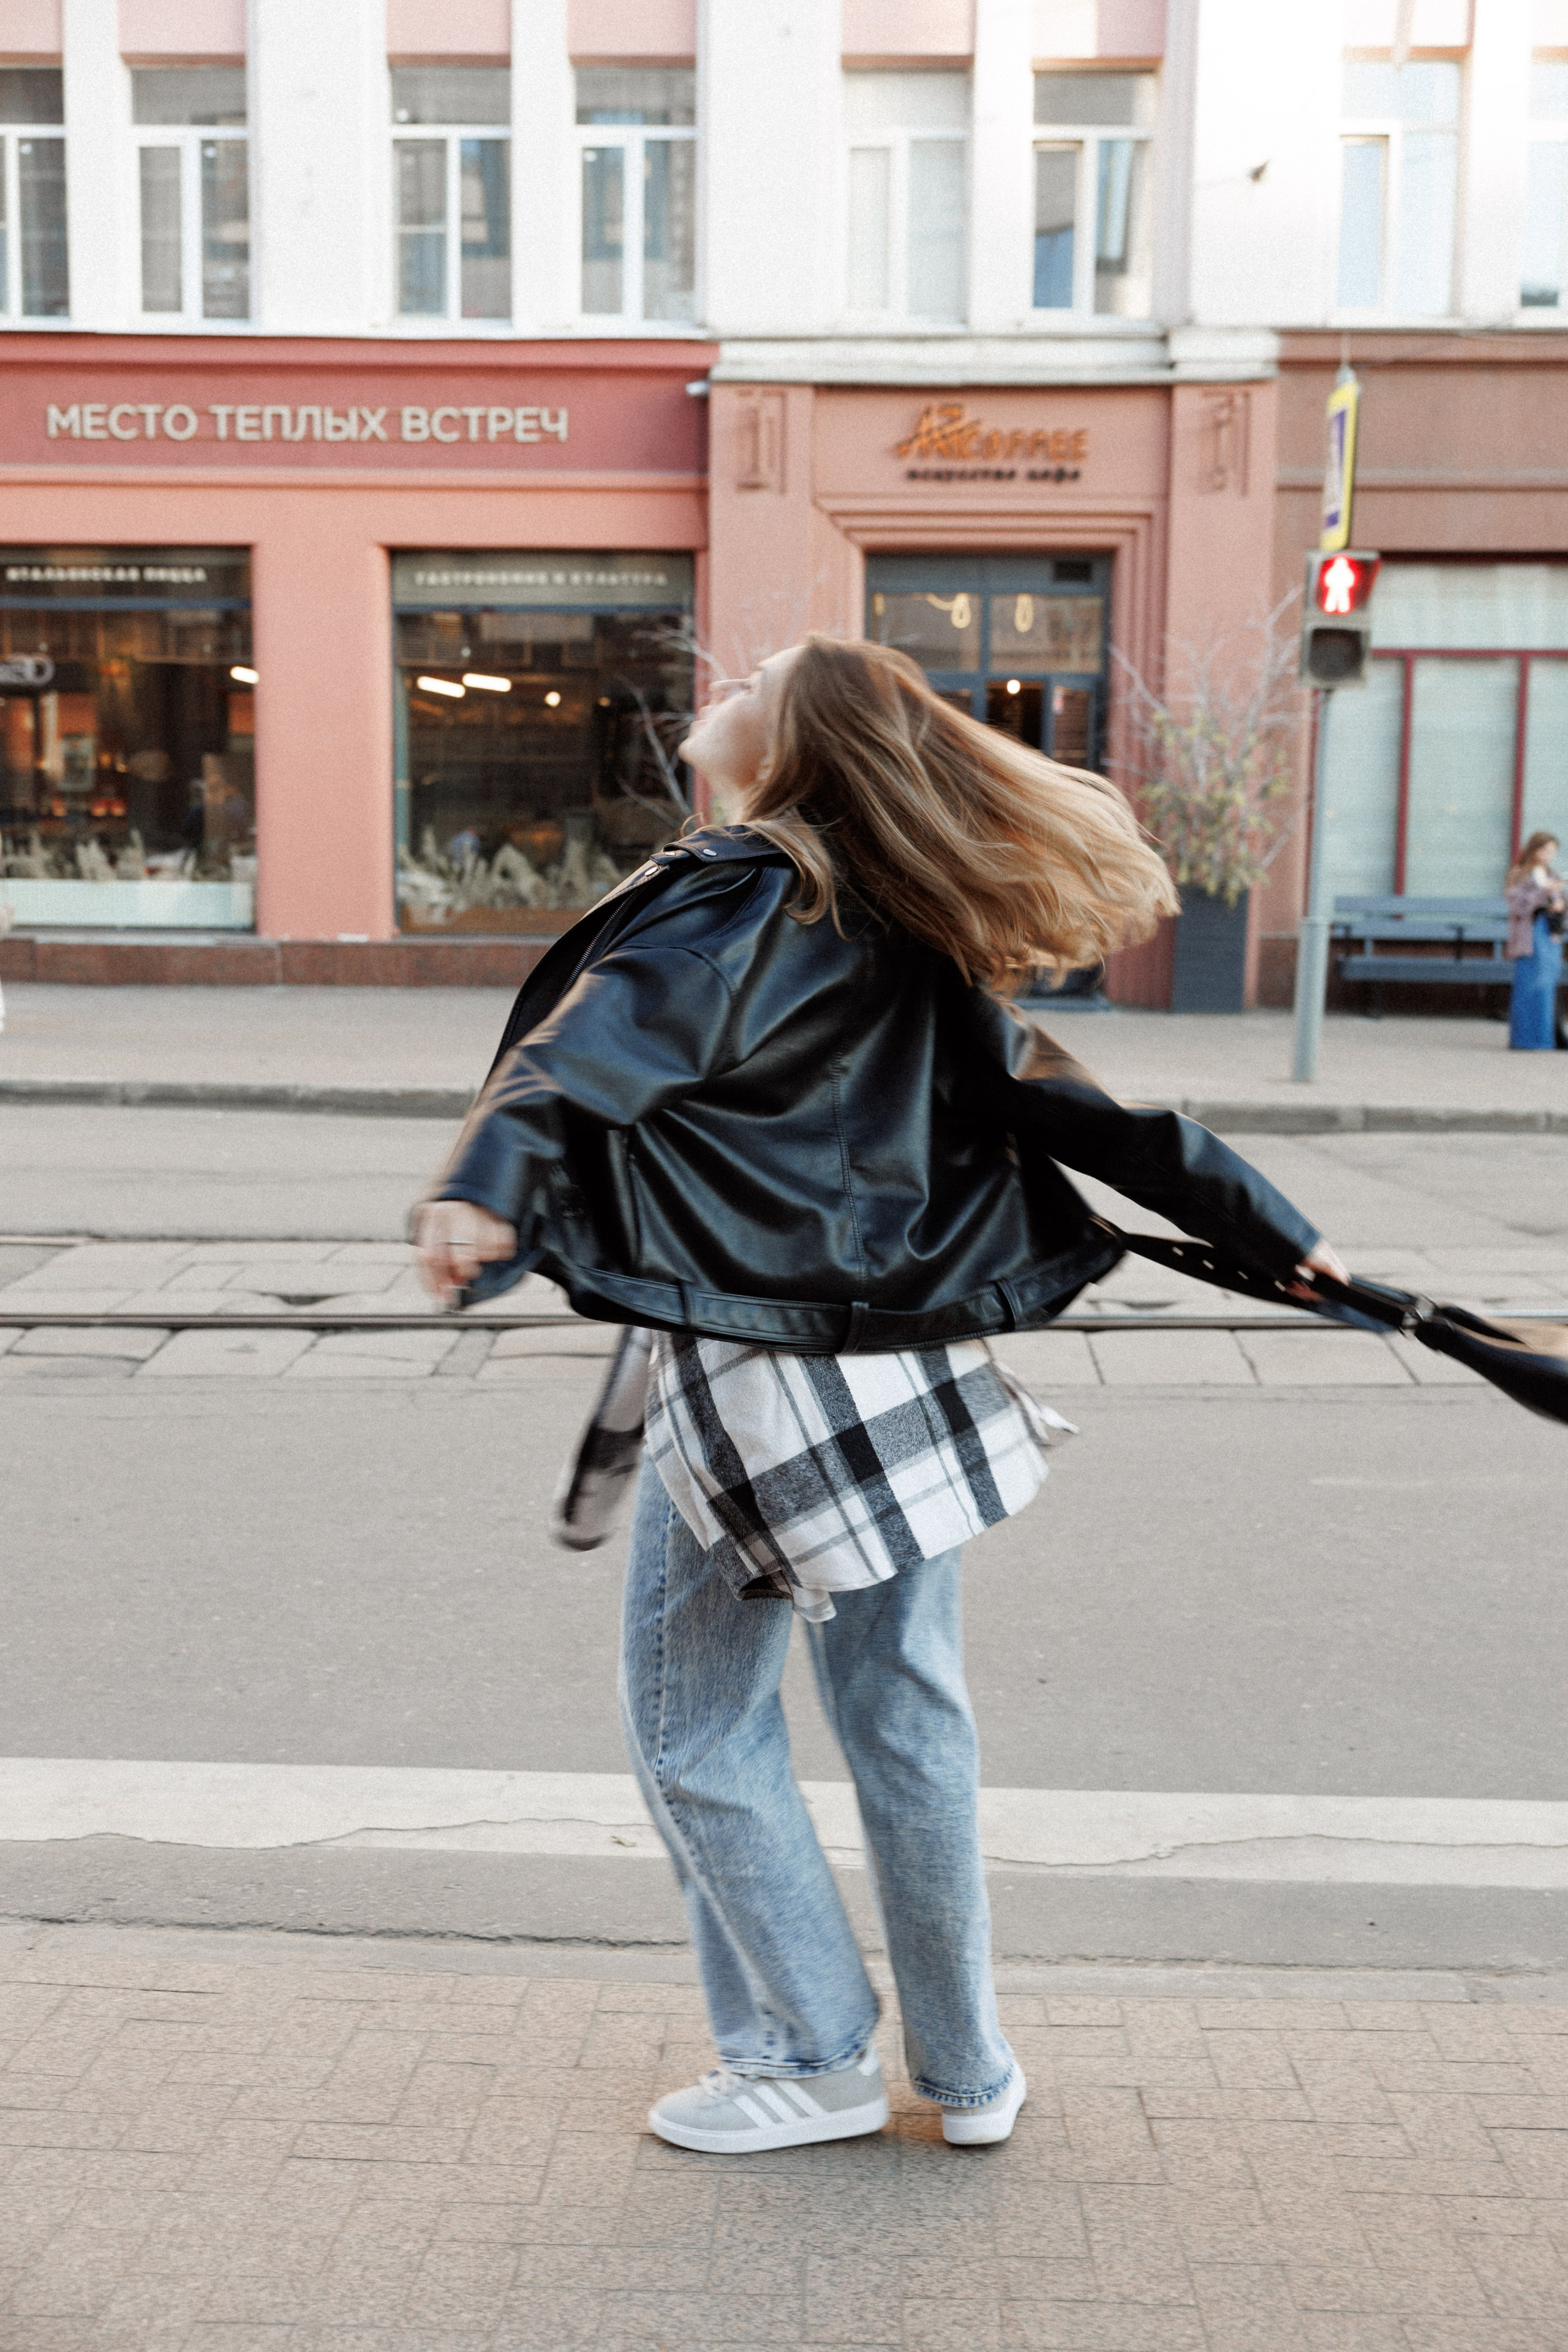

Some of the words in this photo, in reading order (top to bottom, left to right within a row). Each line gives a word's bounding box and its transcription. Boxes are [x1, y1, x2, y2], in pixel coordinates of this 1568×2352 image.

[46, 403, 199, 441] МЕСТО
[209, 404, 388, 442] ТЕПЛЫХ
[400, 405, 570, 443] ВСТРЕЧ
